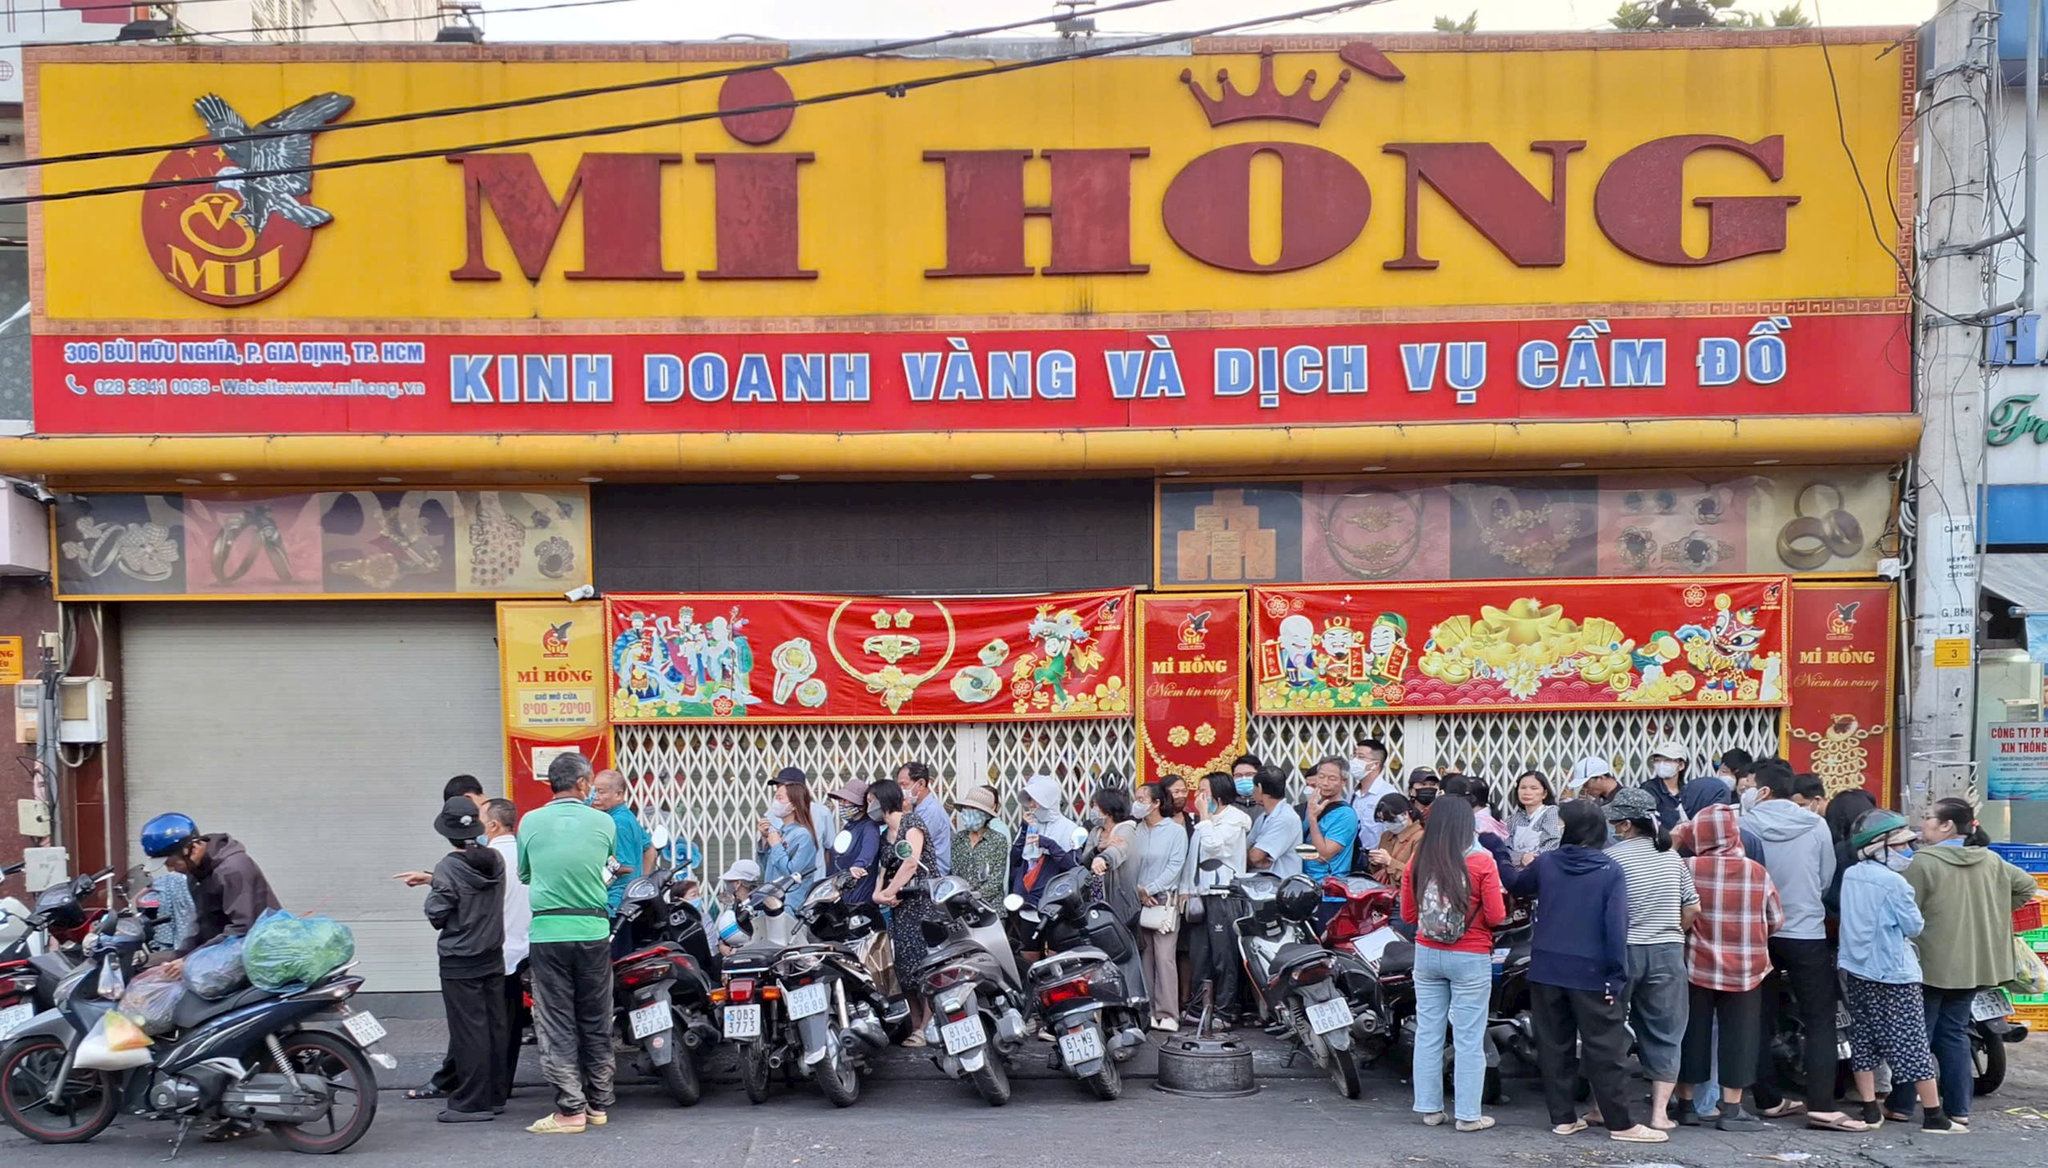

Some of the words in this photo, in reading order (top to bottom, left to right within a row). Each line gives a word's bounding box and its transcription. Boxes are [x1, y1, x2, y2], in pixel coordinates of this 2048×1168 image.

[65, 343, 99, 363] 306
[102, 338, 135, 363] BÙI
[138, 339, 176, 363] HỮU
[180, 339, 243, 365] NGHĨA,
[245, 342, 262, 363] P.
[265, 342, 299, 363] GIA
[301, 342, 350, 367] ĐỊNH,
[352, 342, 379, 363] TP.
[382, 342, 425, 363] HCM
[449, 353, 613, 403] KINH
[643, 352, 870, 403] DOANH
[901, 337, 1076, 400] VÀNG
[1104, 335, 1186, 399] VÀ
[1213, 344, 1368, 408] DỊCH
[1400, 341, 1487, 404] VỤ
[1517, 319, 1666, 389] CẦM
[1695, 316, 1792, 386] ĐỒ
[94, 379, 125, 394] 028
[128, 379, 167, 394] 3841
[170, 379, 210, 394] 0068
[1146, 681, 1184, 697] Niềm
[1185, 686, 1202, 697] tin
[1991, 726, 2015, 739] CÔNG
[2017, 727, 2028, 738] TY
[2030, 727, 2041, 738] TP
[2001, 742, 2016, 753] XIN
[2018, 740, 2048, 753] THÔNG
[729, 1020, 756, 1034] 3773
